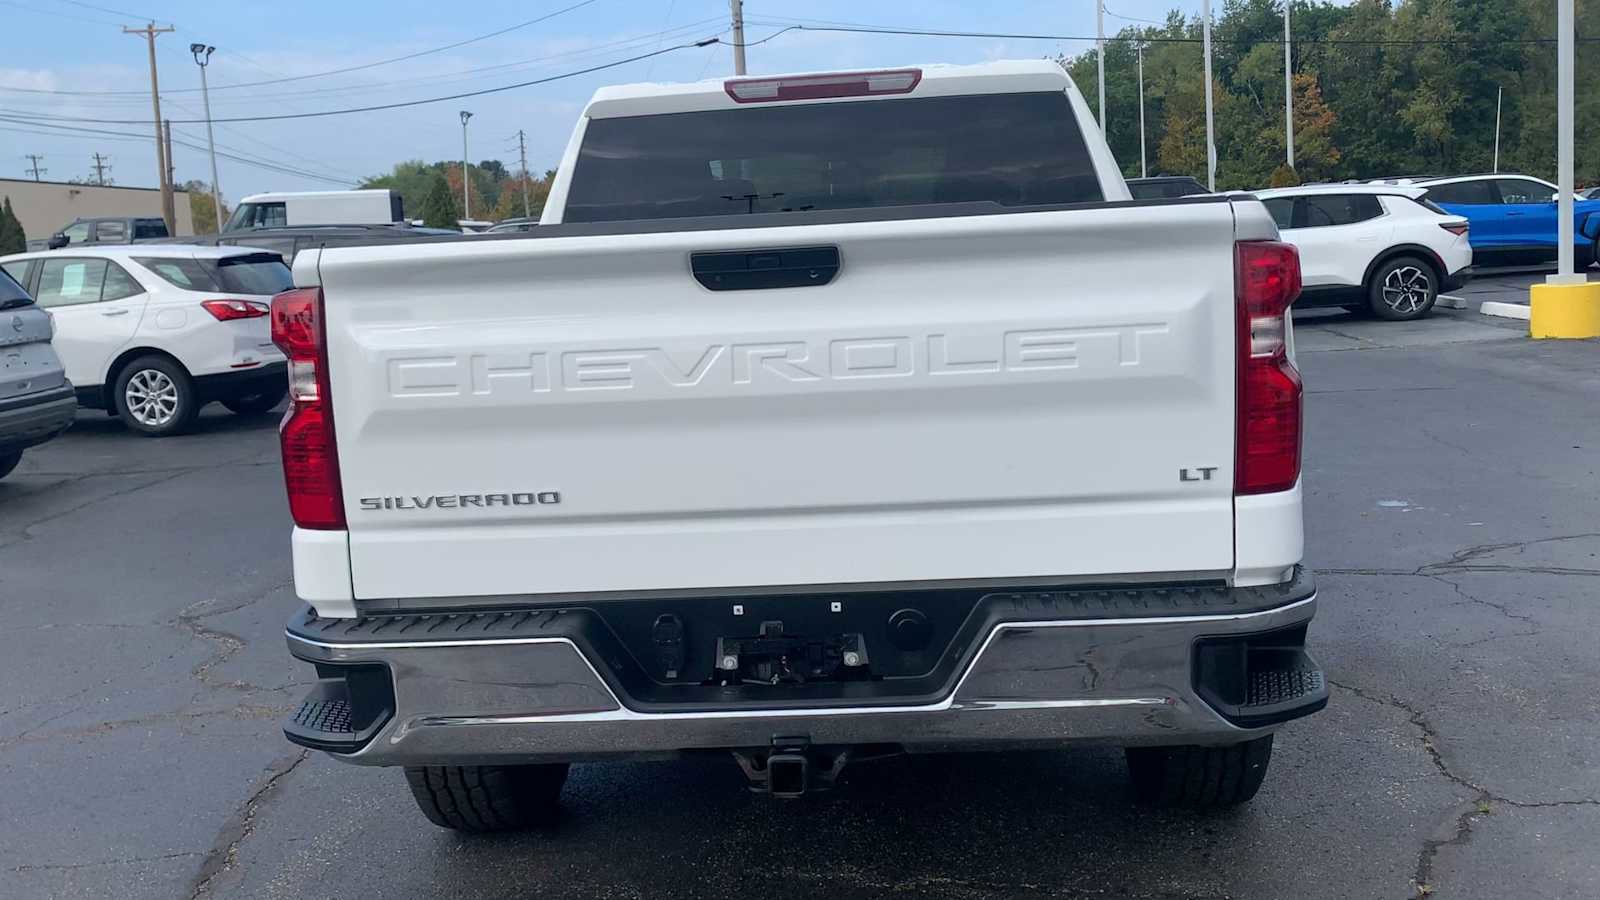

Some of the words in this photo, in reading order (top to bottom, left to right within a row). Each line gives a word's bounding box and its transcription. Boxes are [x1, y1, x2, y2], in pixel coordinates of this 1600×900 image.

[387, 322, 1169, 398] CHEVROLET
[1179, 467, 1218, 481] LT
[360, 491, 561, 510] SILVERADO
